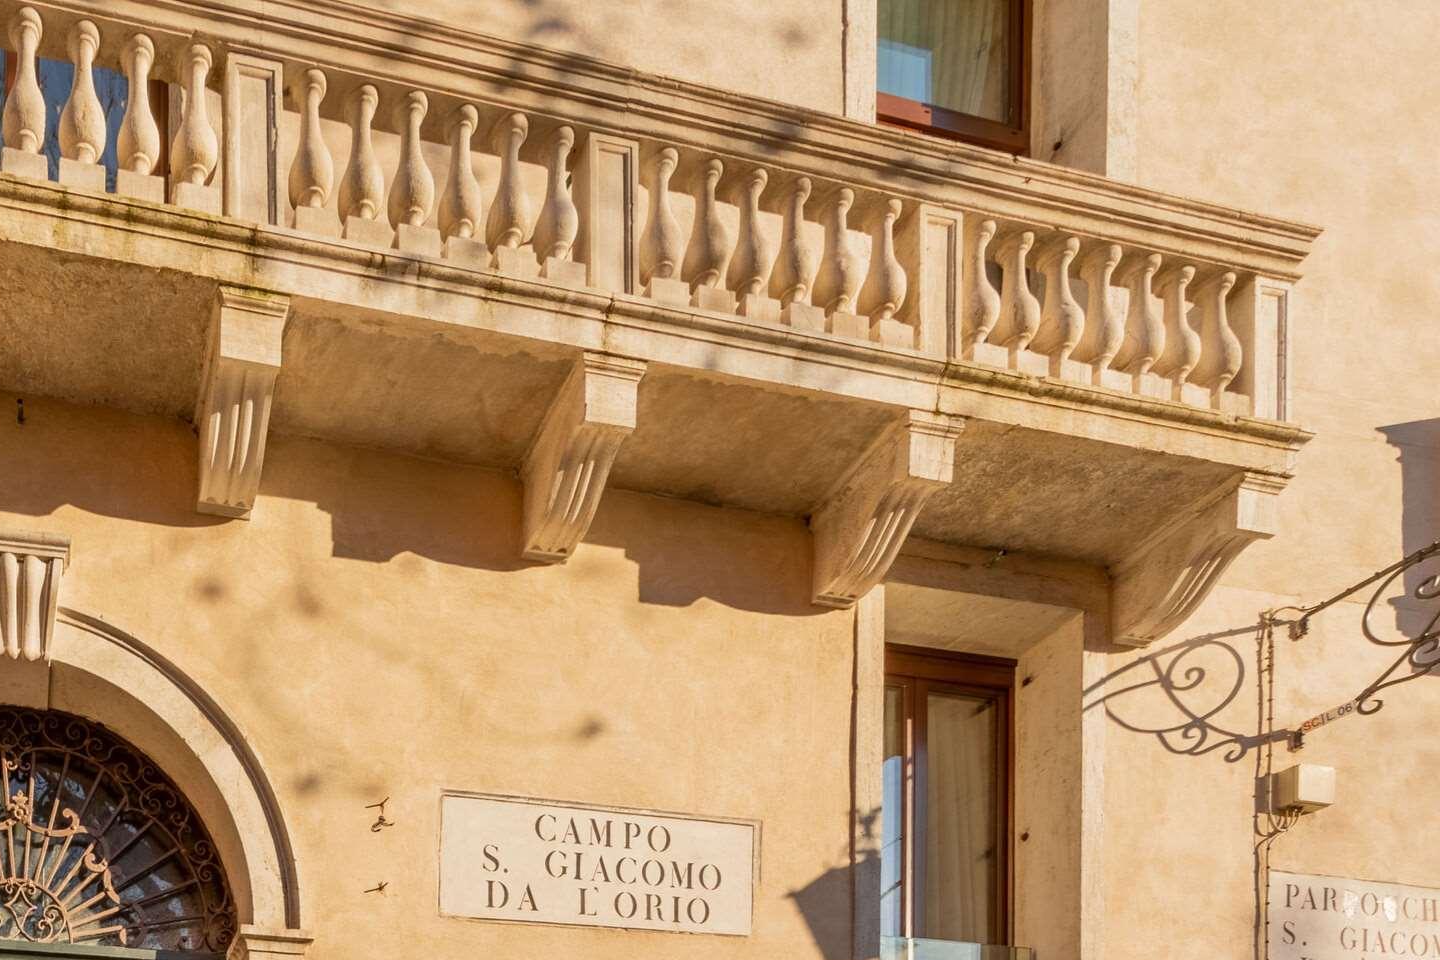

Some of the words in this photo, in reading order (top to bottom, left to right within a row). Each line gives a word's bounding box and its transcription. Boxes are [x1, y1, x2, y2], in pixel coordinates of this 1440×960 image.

[534, 813, 671, 852] CAMPO
[482, 844, 509, 874] S.
[544, 850, 722, 891] GIACOMO
[485, 879, 539, 912] DA
[578, 887, 710, 925] L'ORIO
[1284, 883, 1438, 922] PAROCH
[1282, 920, 1307, 947] S.
